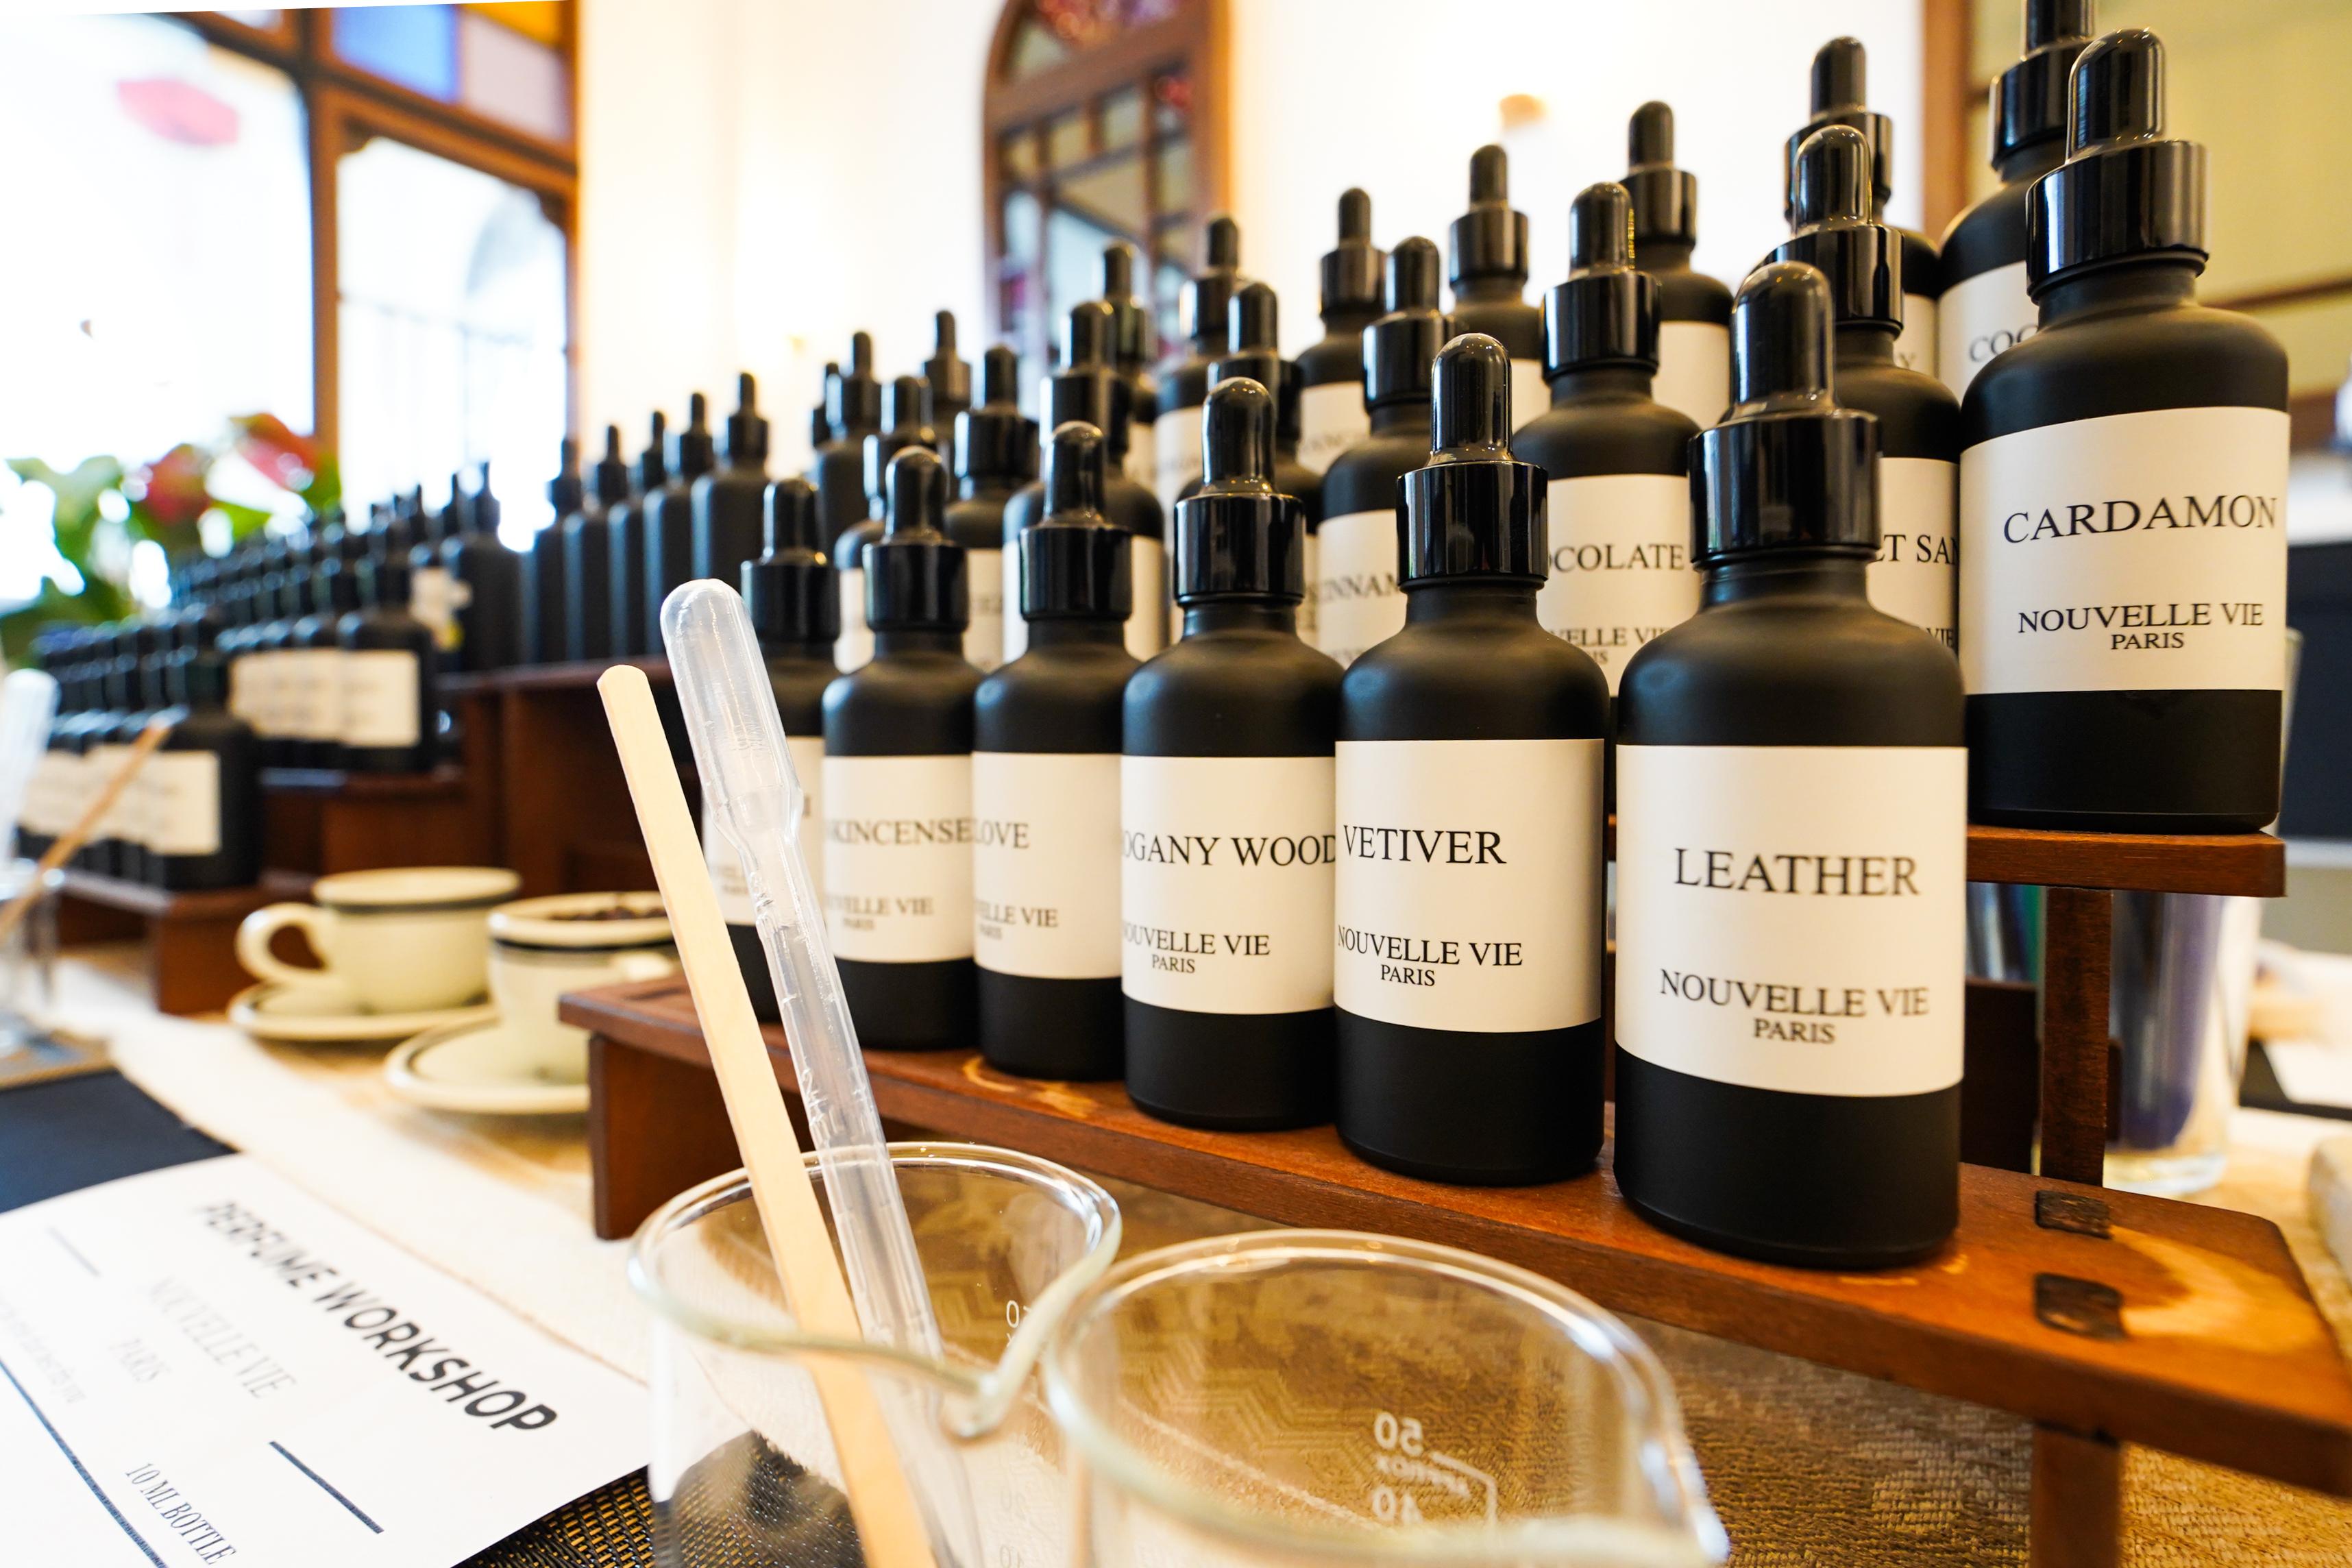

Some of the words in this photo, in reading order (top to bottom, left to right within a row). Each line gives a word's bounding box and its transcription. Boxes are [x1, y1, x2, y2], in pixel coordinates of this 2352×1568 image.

[2003, 494, 2278, 543] CARDAMON
[1547, 544, 1685, 572] COLATE
[1876, 534, 1907, 563] T
[2018, 603, 2211, 633] NOUVELLE
[2220, 602, 2264, 626] VIE
[2110, 632, 2184, 650] PARIS
[1343, 825, 1507, 863] VETIVER
[1674, 848, 1921, 896] LEATHER
[1020, 906, 1059, 927] VIE
[1223, 934, 1271, 955] VIE
[1338, 924, 1460, 965] NOUVELLE
[1469, 942, 1523, 966] VIE
[1151, 954, 1196, 974] PARIS
[1381, 964, 1436, 986] PARIS
[1659, 968, 1867, 1018] NOUVELLE
[1876, 987, 1930, 1016] VIE
[1753, 1018, 1836, 1044] PARIS
[313, 1282, 559, 1430] WORKSHOP
[236, 1355, 297, 1399] VIE
[125, 1462, 161, 1485] 10
[139, 1480, 181, 1510] ML
[160, 1502, 238, 1565] BOTTLE
